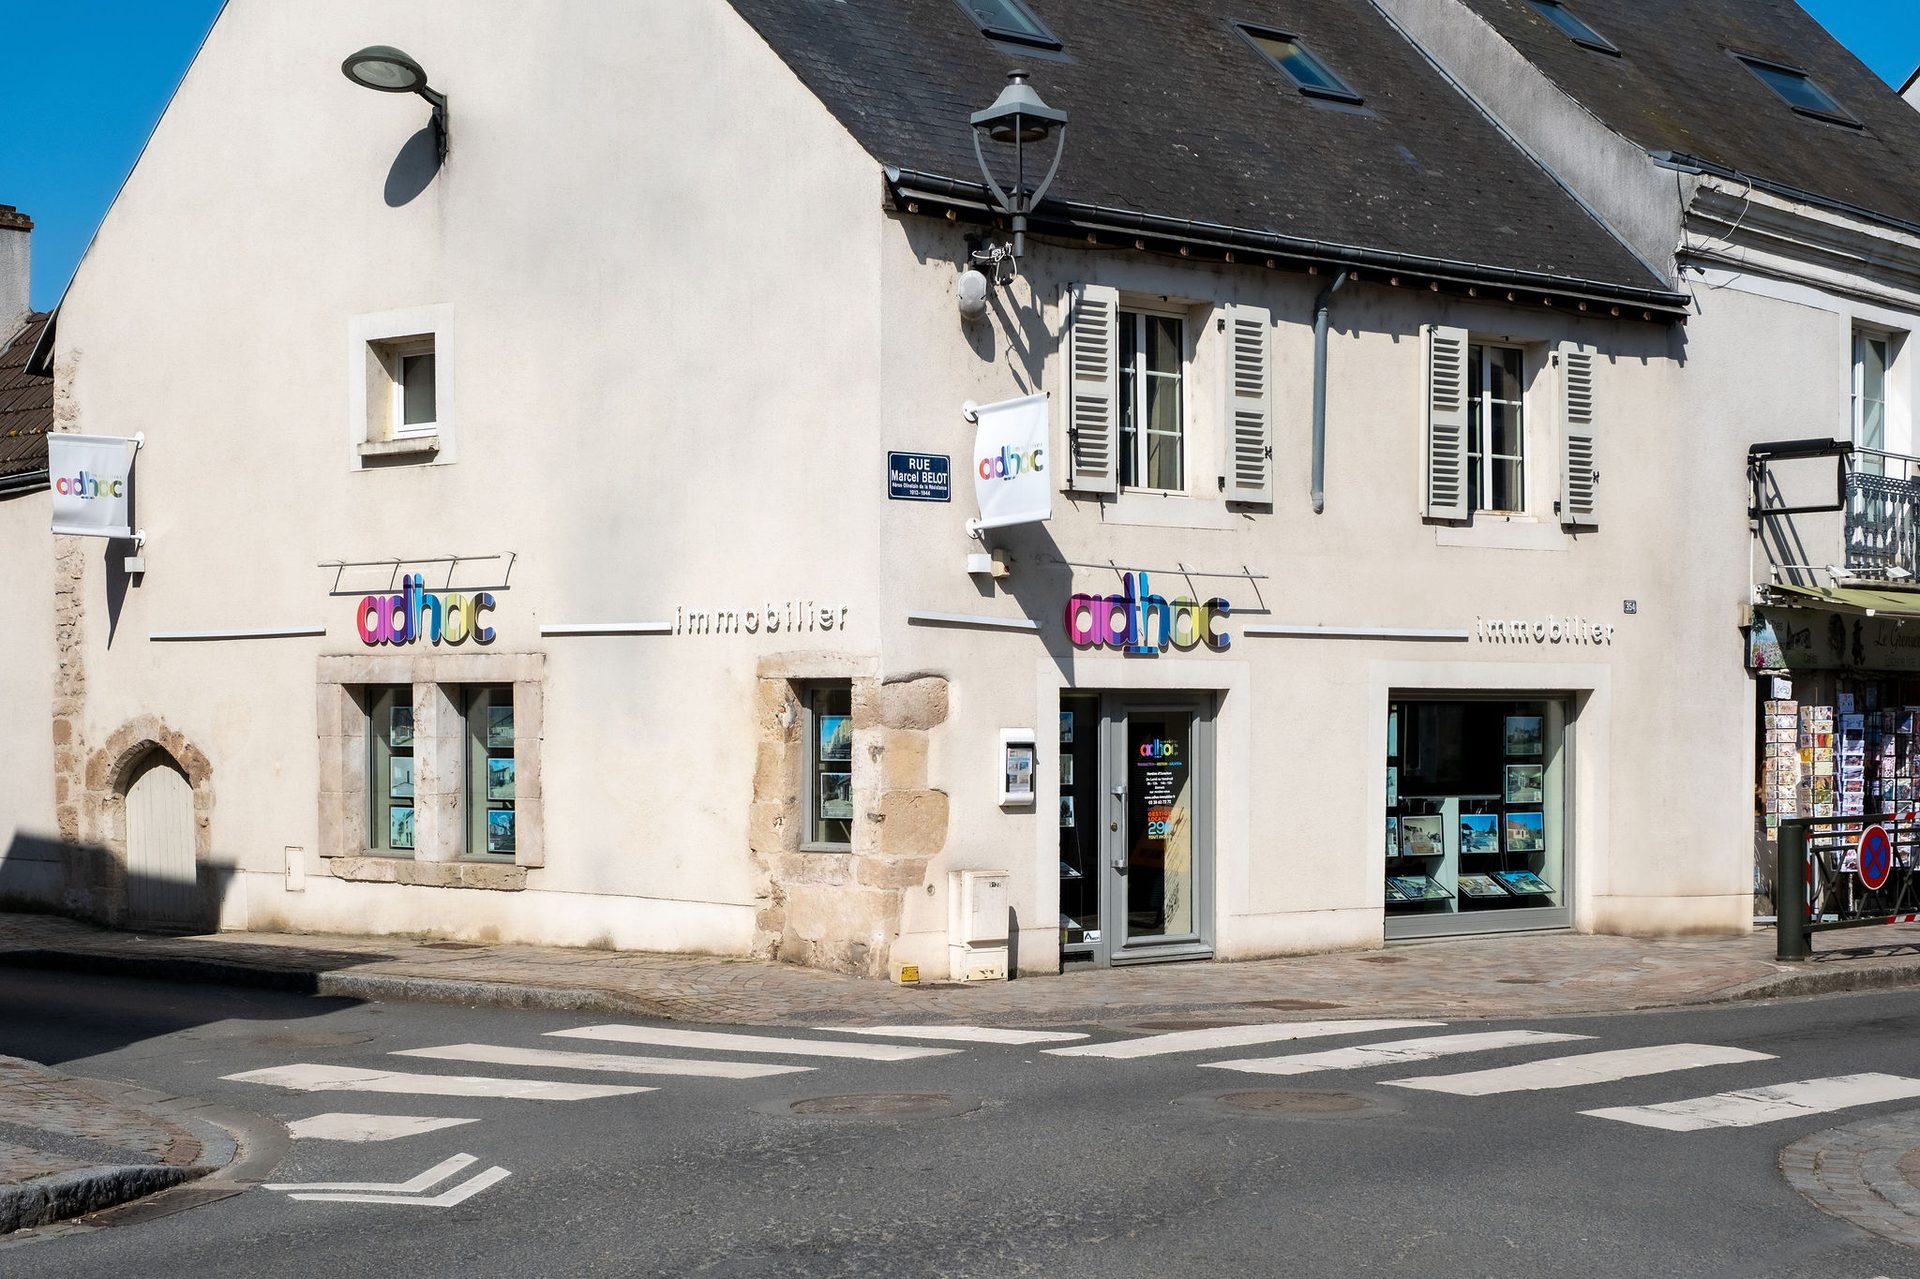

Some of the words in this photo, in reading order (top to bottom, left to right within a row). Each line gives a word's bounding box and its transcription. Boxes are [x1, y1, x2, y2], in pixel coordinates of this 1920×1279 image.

[891, 469, 919, 483] Marcel
[922, 471, 948, 484] BELOT
[909, 458, 930, 471] RUE
[979, 445, 1044, 481] adhoc
[56, 470, 123, 499] adhoc
[357, 572, 497, 645] adhoc
[674, 598, 849, 634] immobilier
[1064, 570, 1232, 653] adhoc
[1476, 614, 1615, 645] immobilier
